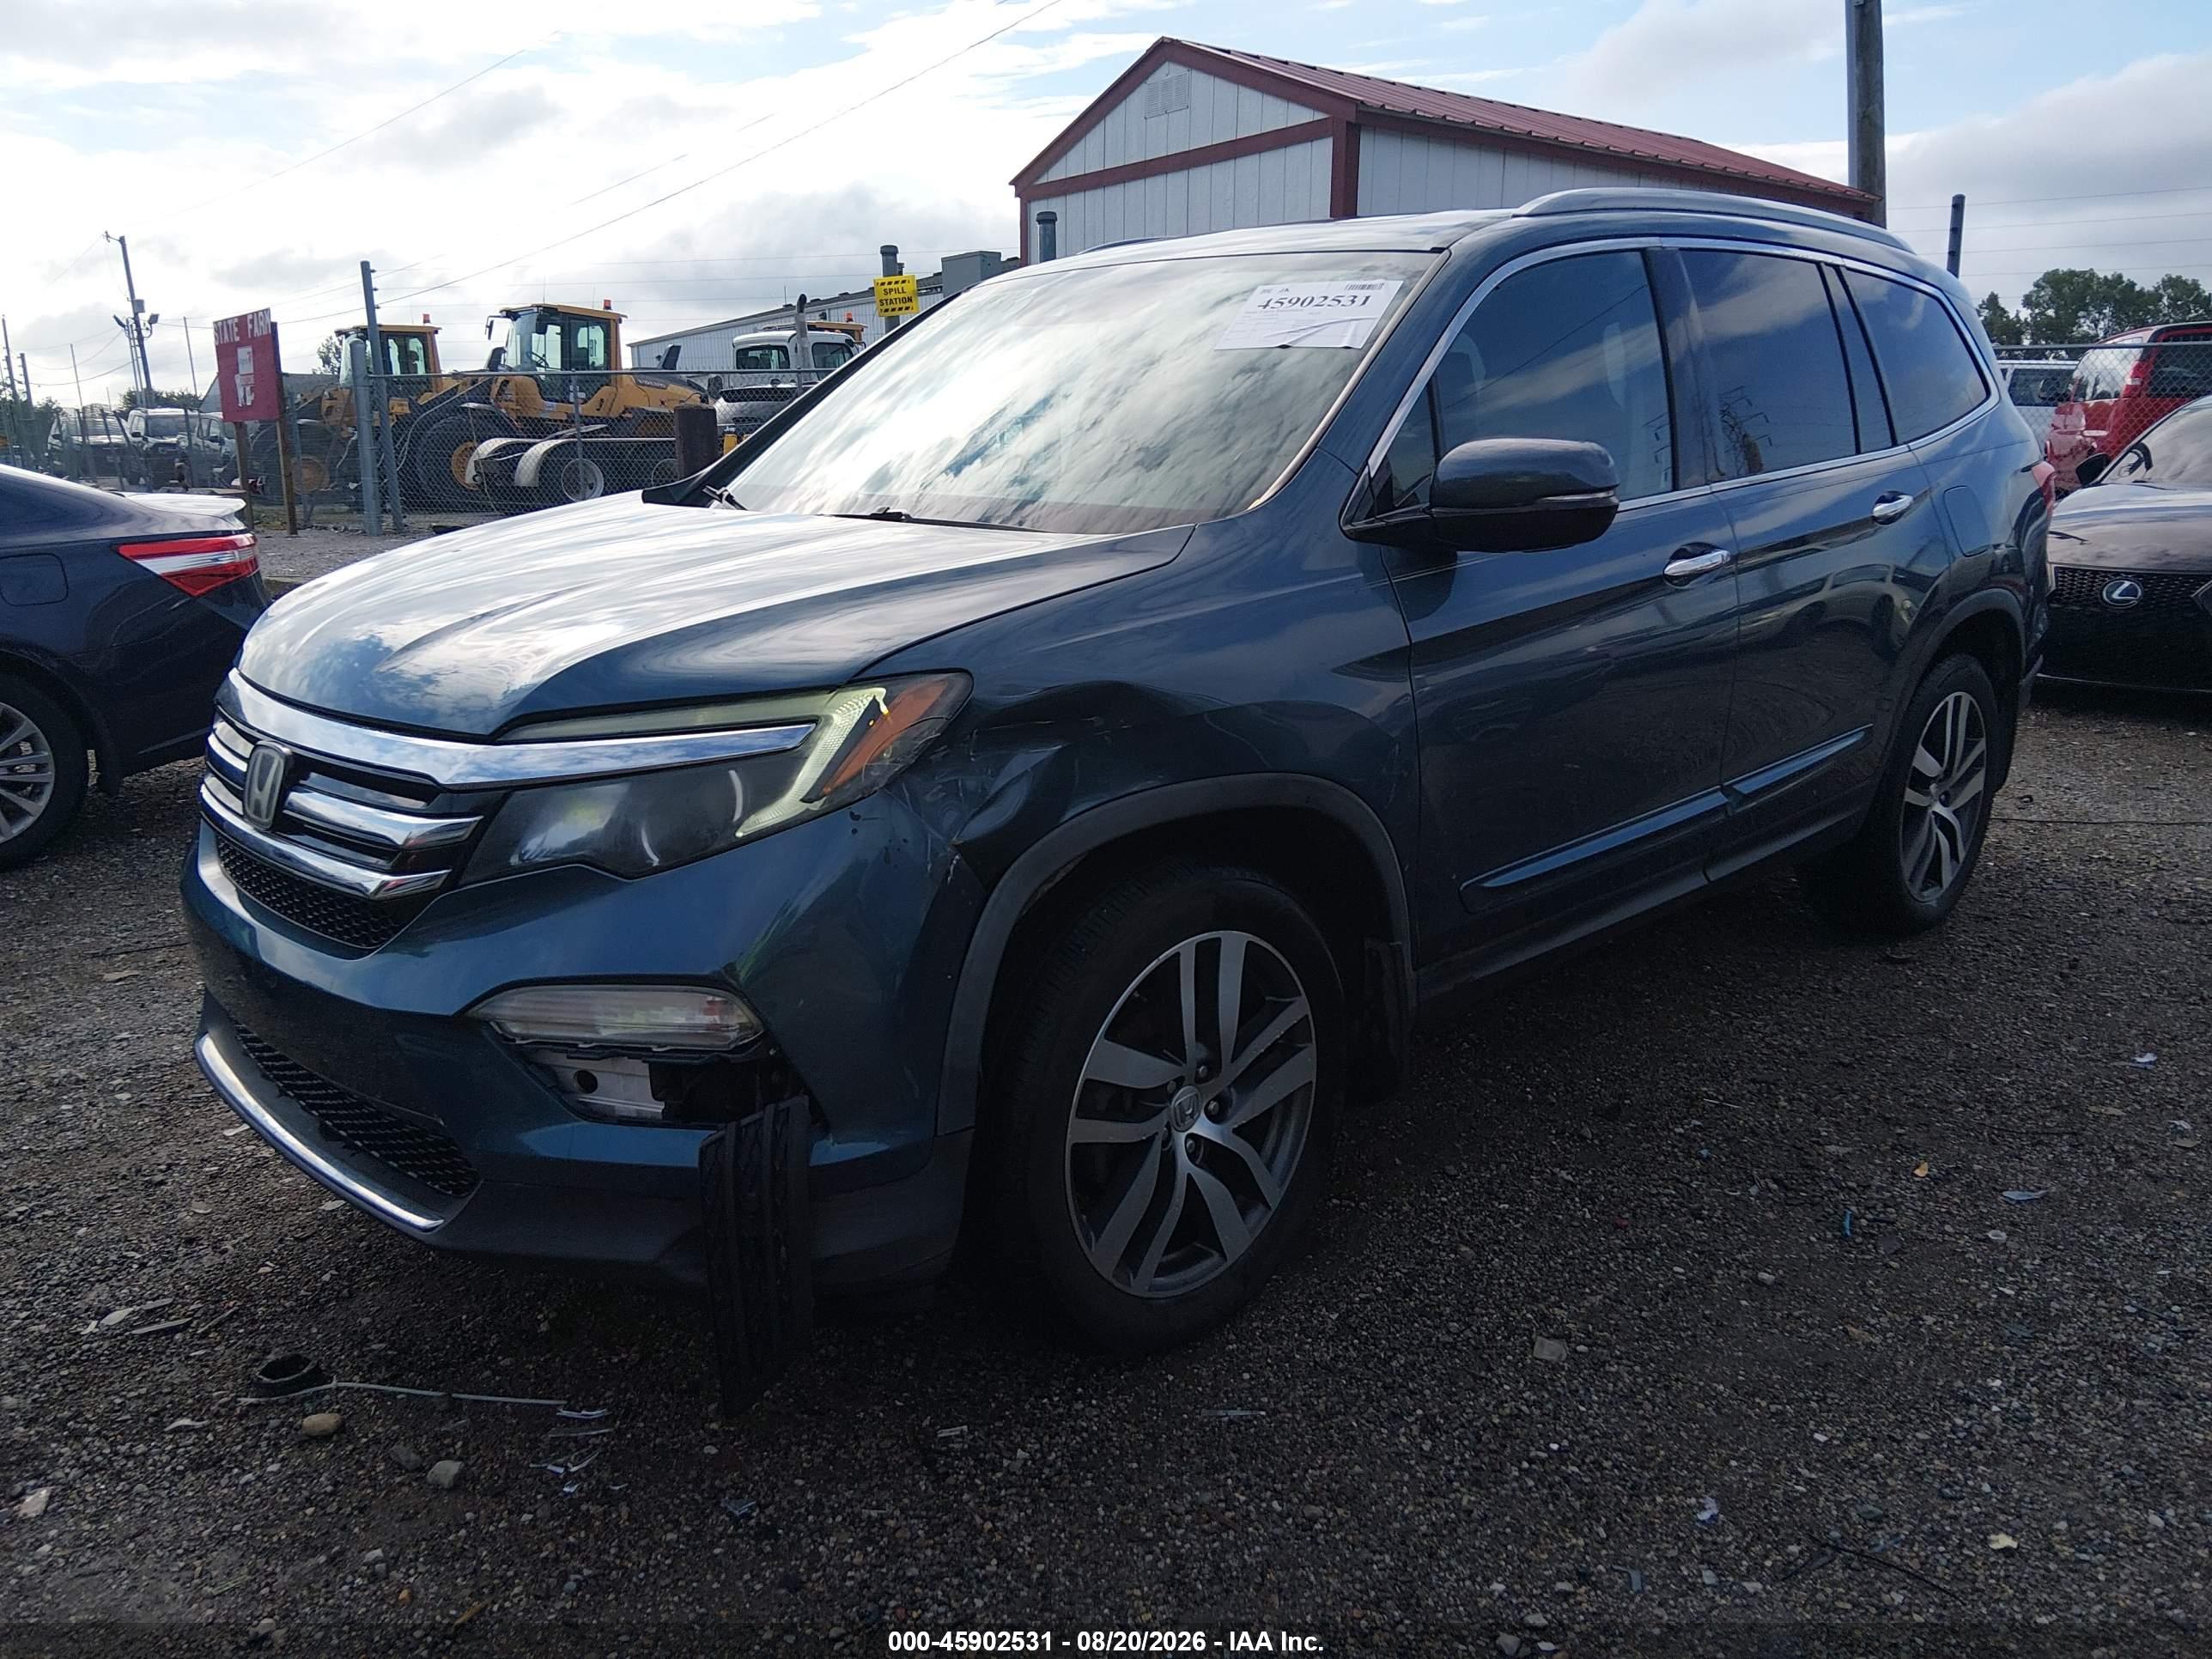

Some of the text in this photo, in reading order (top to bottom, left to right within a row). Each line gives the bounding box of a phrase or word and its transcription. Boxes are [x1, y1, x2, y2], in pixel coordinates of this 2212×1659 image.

[883, 287, 906, 295] SPILL
[879, 296, 913, 306] STATION
[1257, 295, 1372, 310] 45902531
[213, 310, 270, 345] STATE FARM
